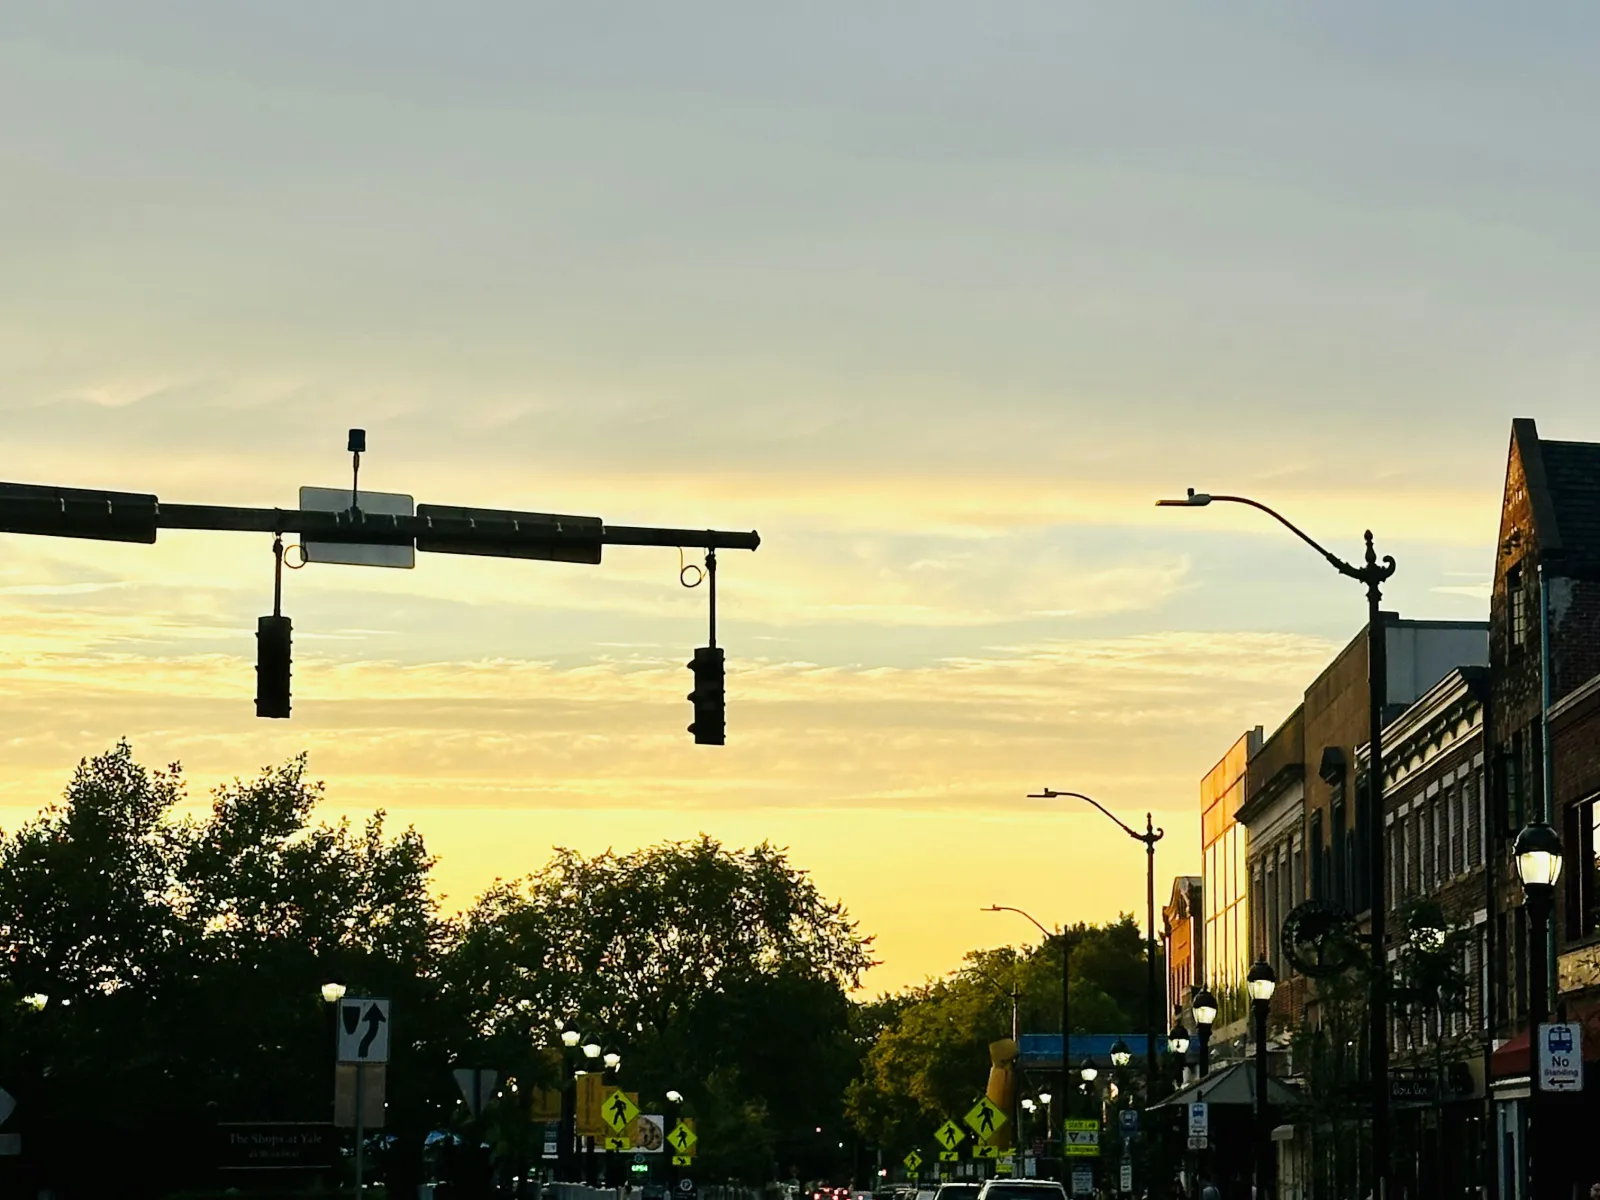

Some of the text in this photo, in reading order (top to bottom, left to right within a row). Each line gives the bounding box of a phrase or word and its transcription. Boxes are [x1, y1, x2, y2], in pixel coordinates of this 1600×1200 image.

[1551, 1055, 1570, 1068] No
[1543, 1068, 1579, 1079] Standing
[229, 1132, 323, 1149] The Shops at Yale
